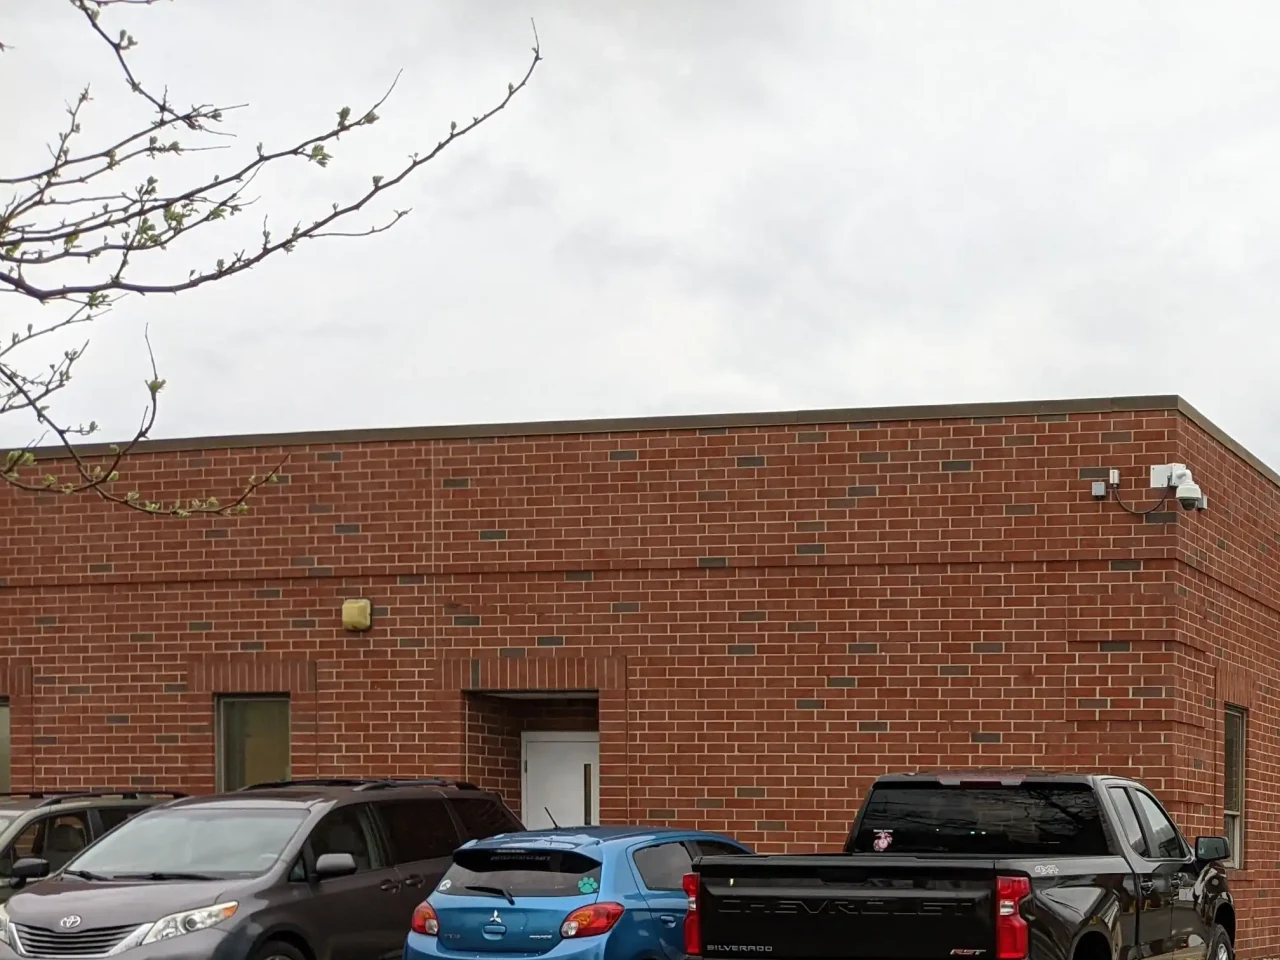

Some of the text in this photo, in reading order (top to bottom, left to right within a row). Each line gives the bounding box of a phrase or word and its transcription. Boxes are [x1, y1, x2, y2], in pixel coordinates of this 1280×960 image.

[718, 900, 973, 915] CHEVROLET
[706, 944, 773, 952] SILVERADO
[950, 948, 987, 956] RST
